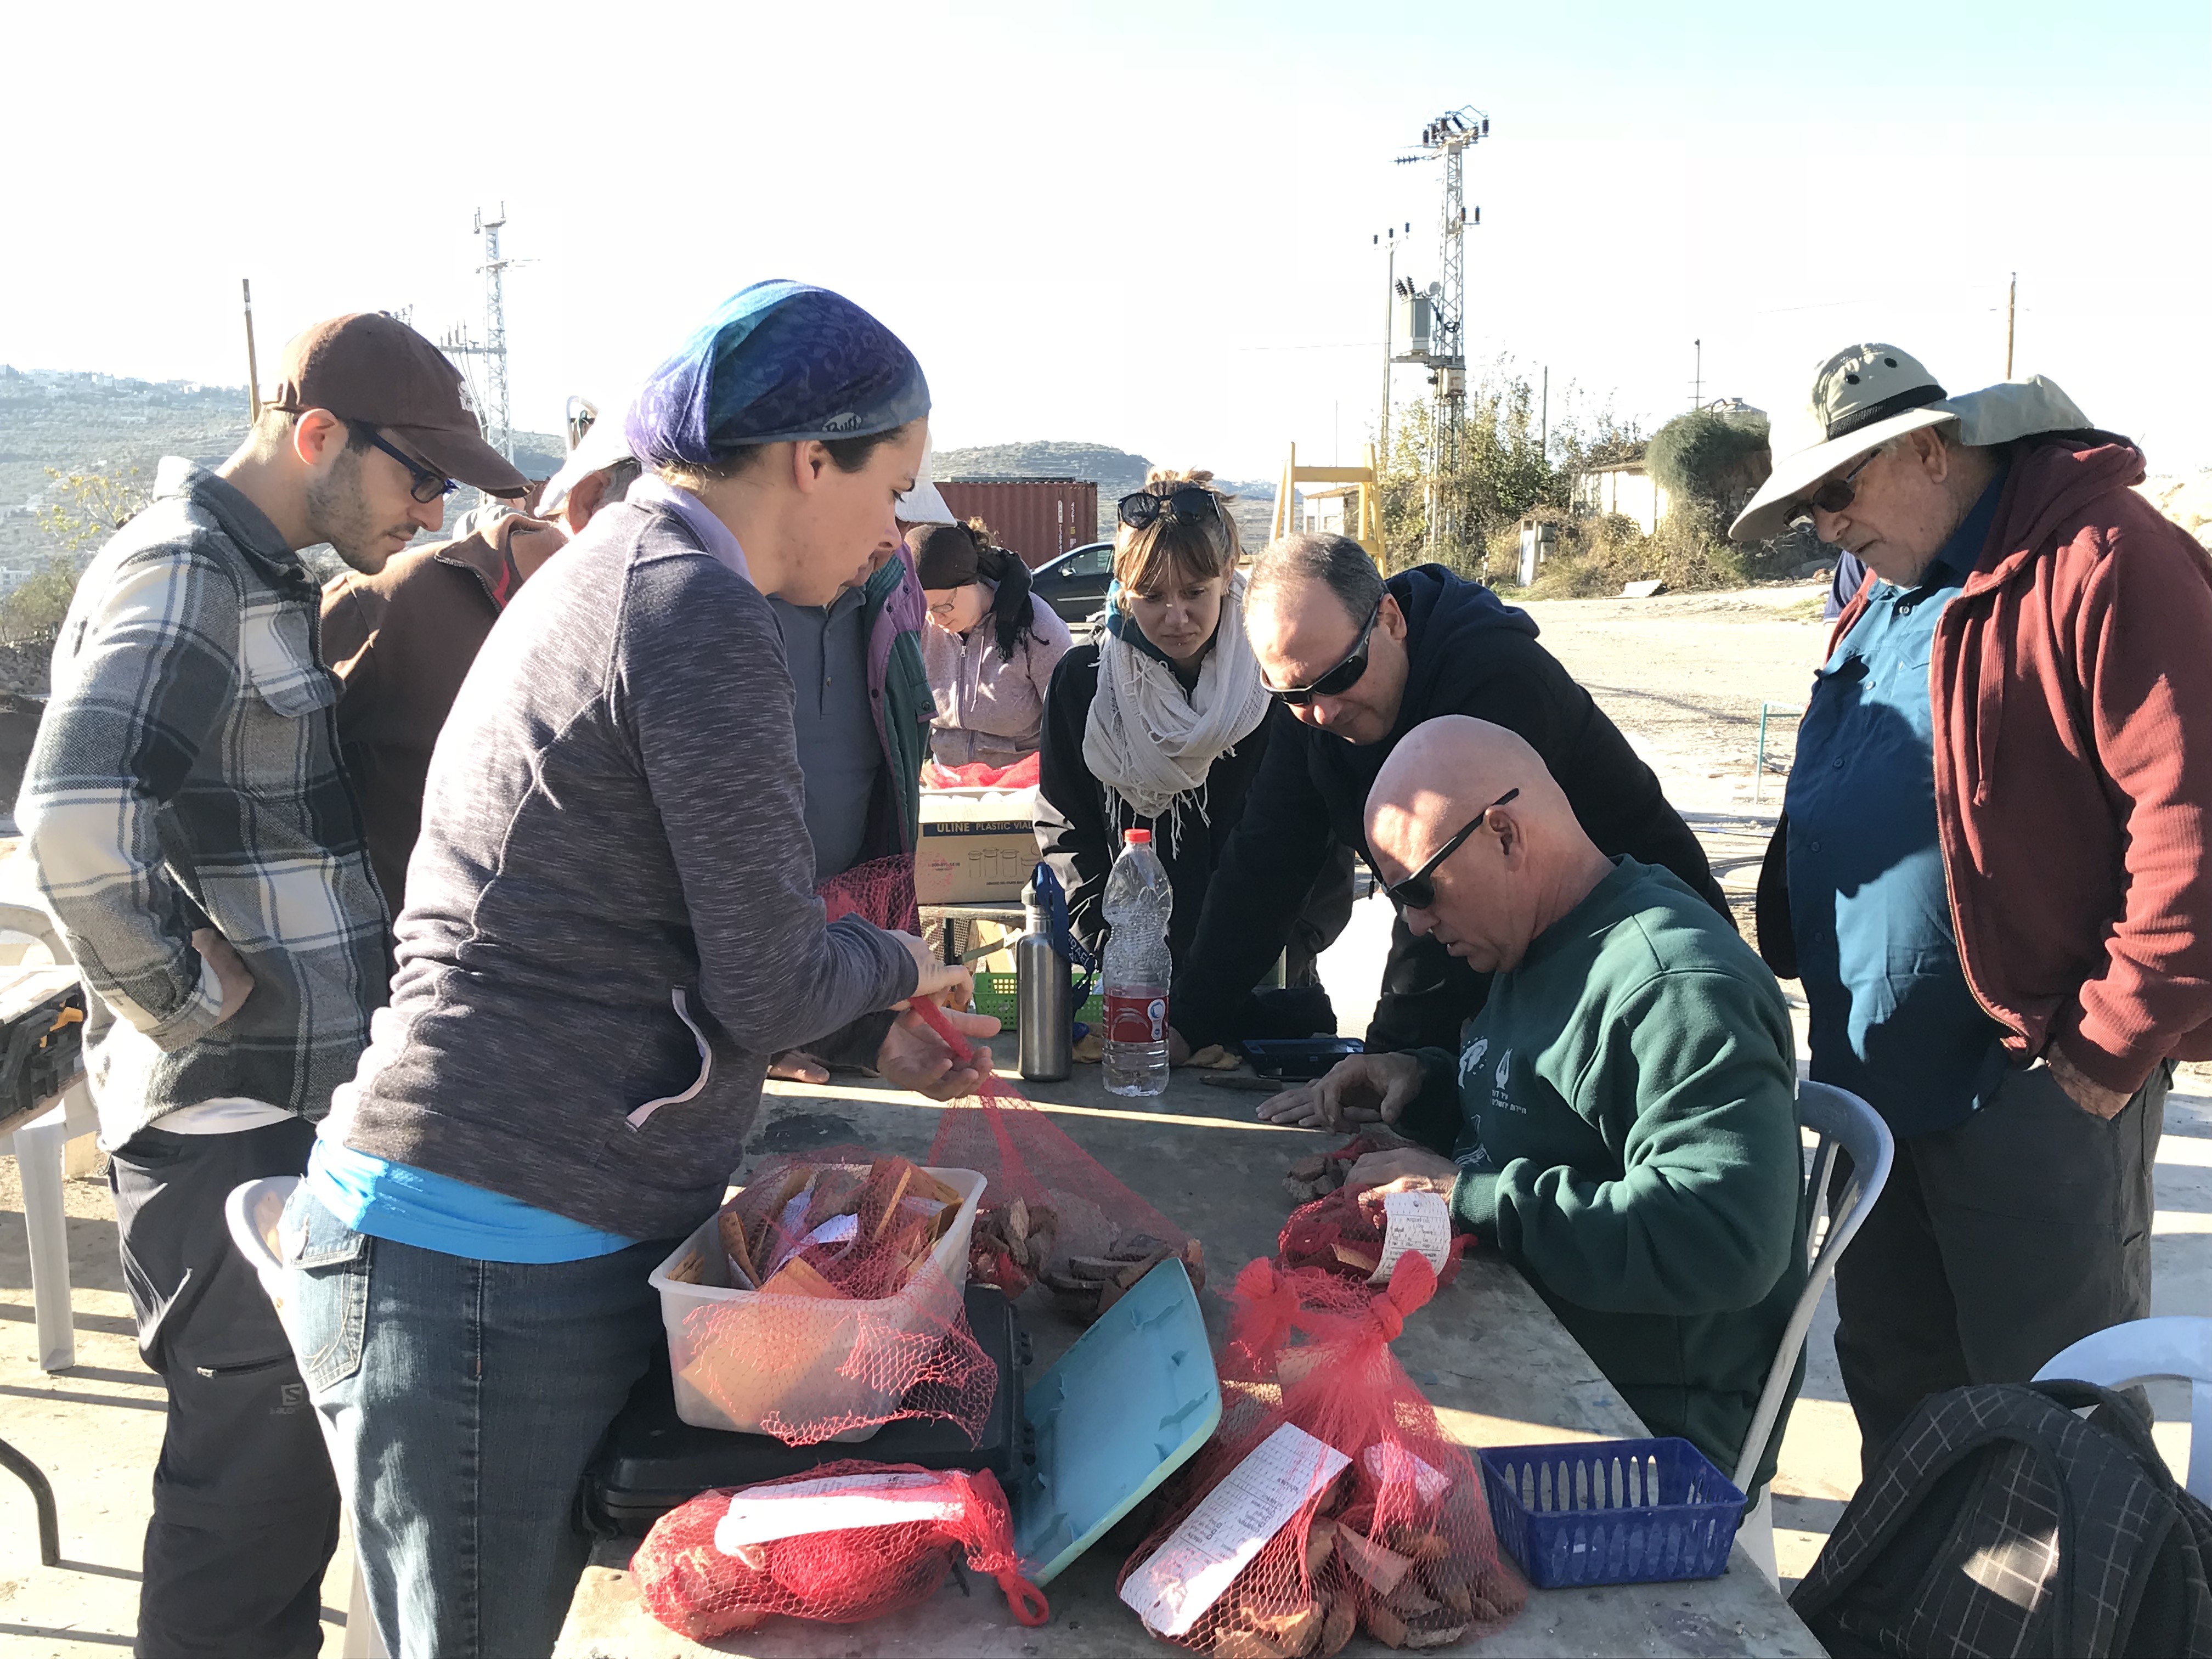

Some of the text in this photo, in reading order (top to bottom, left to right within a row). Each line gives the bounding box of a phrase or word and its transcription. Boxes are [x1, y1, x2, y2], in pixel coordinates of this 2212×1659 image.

[936, 821, 1032, 833] ULINE PLASTIC VIAL
